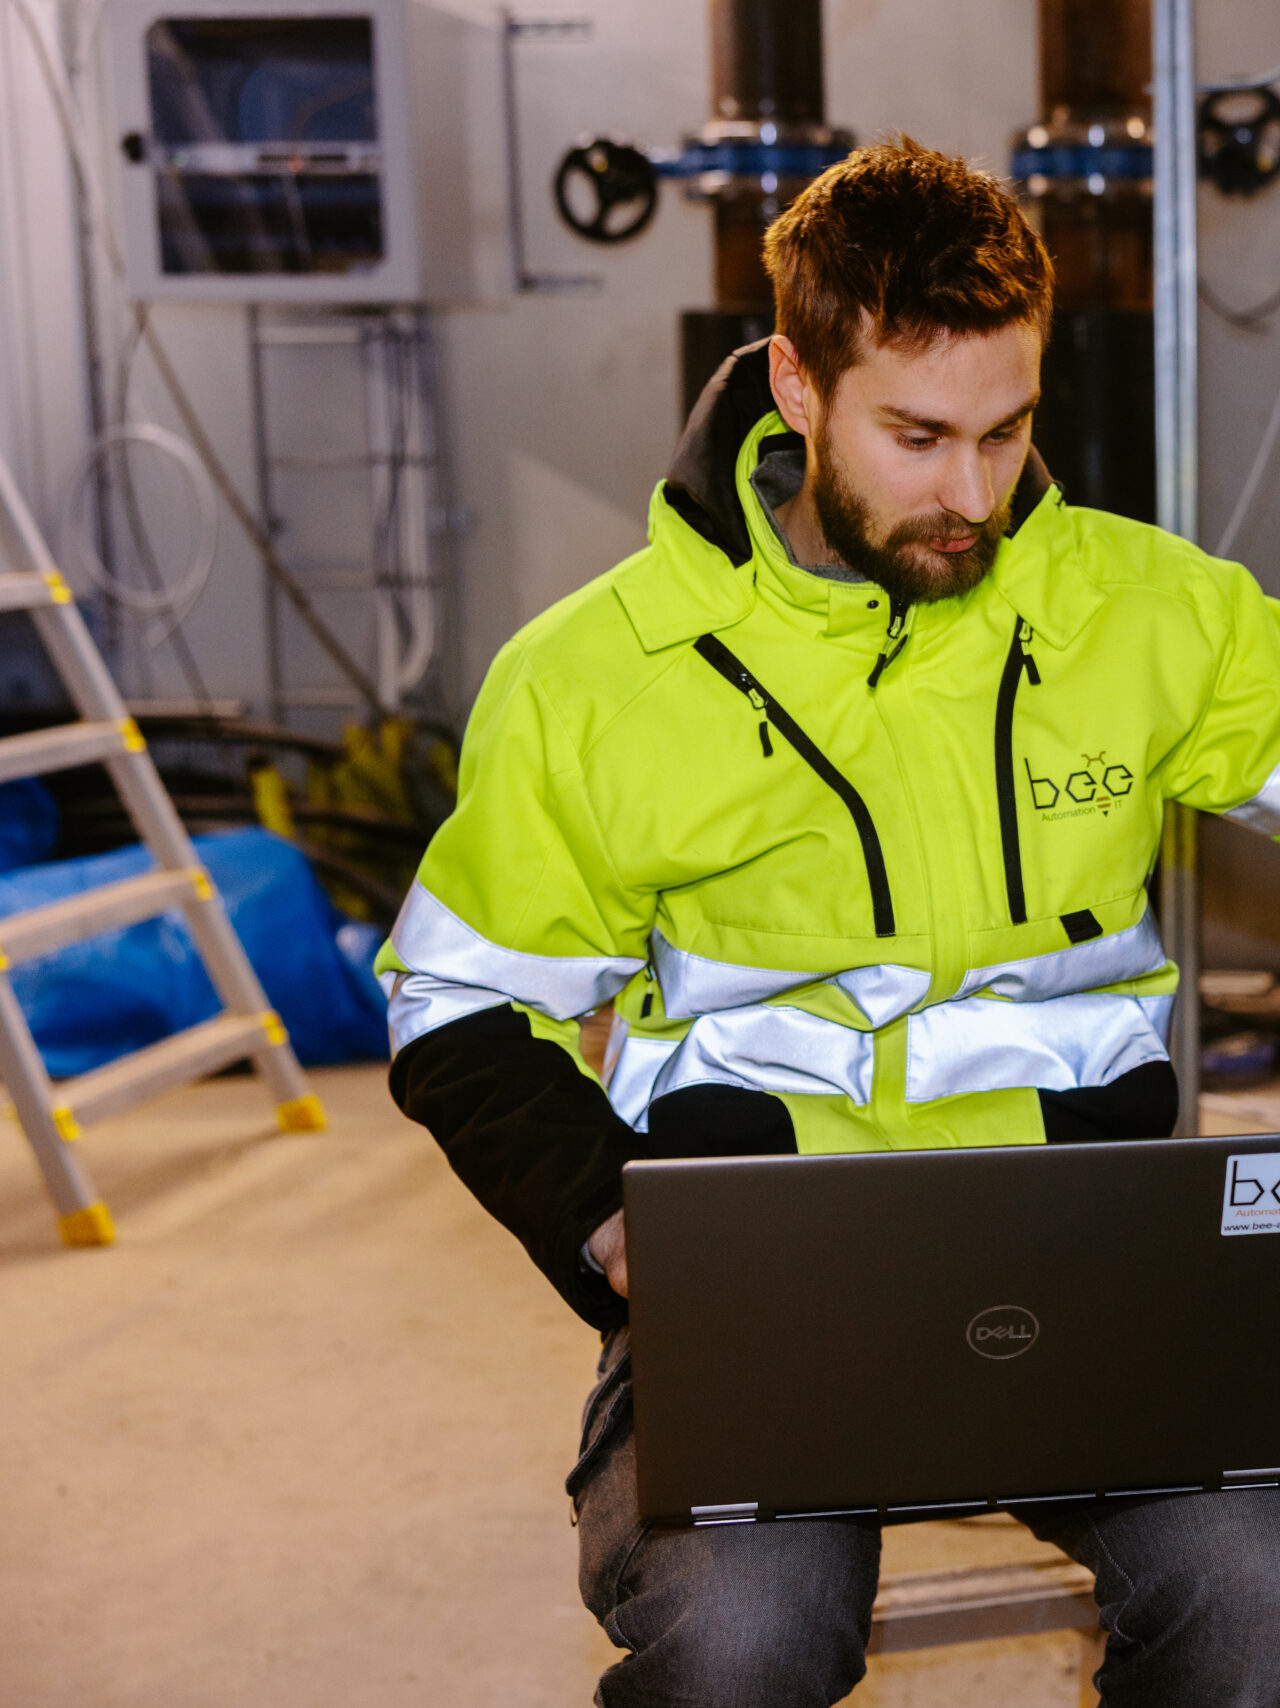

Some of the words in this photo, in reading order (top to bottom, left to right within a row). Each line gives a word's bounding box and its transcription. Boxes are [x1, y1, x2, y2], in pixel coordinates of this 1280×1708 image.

[1024, 757, 1133, 810] bee
[1041, 806, 1096, 822] Automation
[976, 1325, 1031, 1340] DELL
